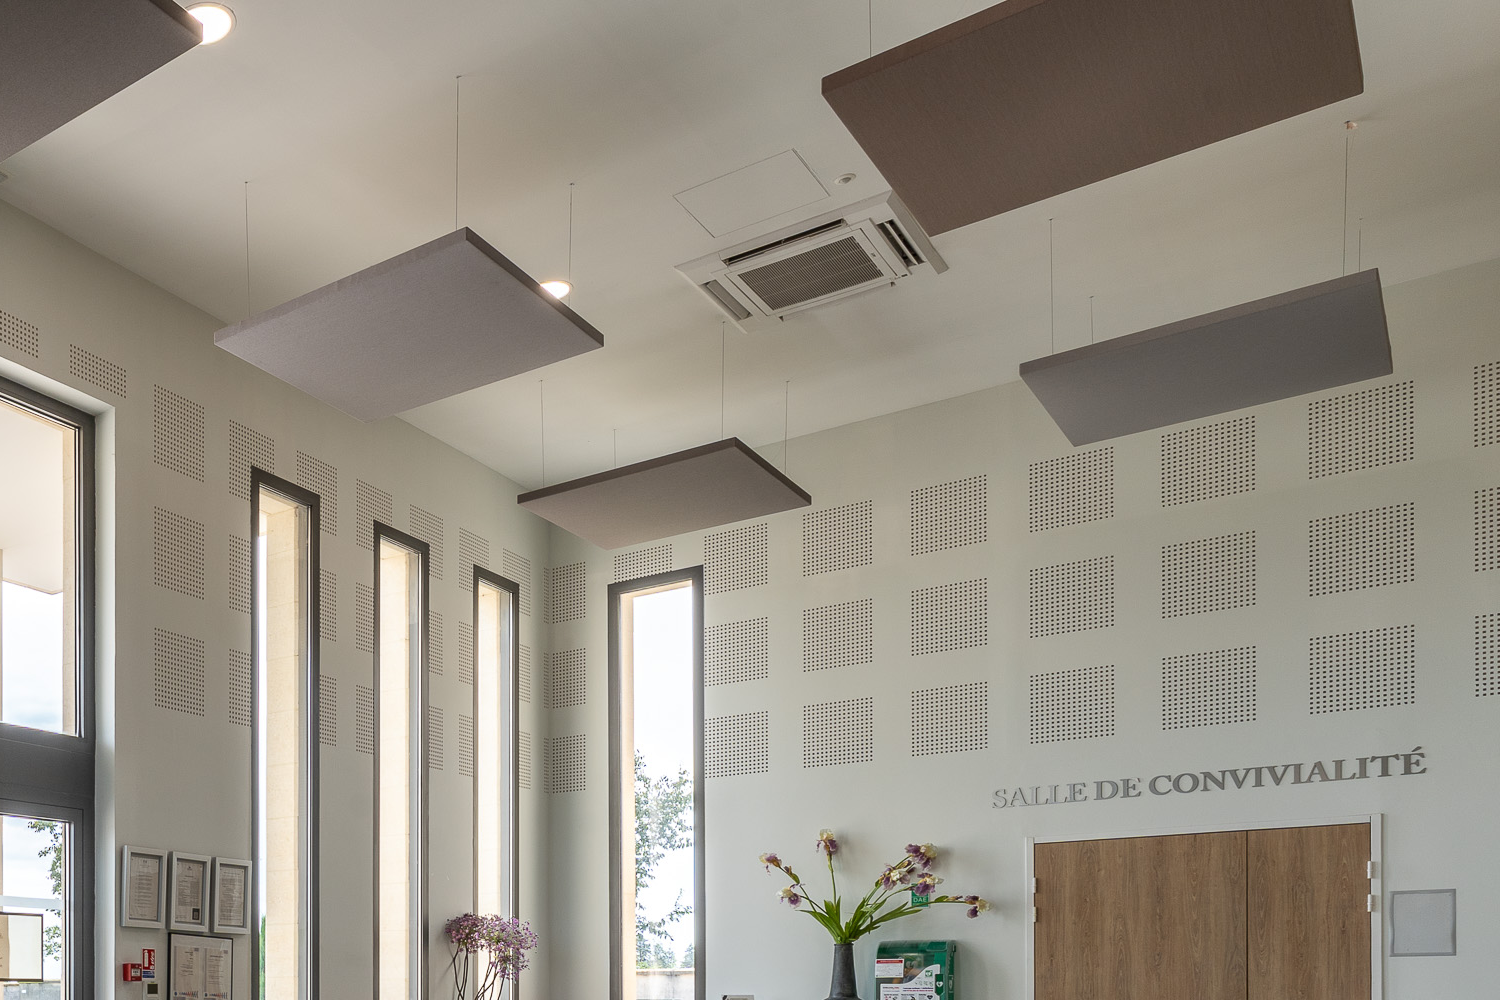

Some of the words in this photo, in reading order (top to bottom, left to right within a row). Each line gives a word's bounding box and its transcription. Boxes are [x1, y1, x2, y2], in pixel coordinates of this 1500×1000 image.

[992, 782, 1088, 809] SALLE
[1094, 777, 1141, 801] DE
[1148, 746, 1427, 796] CONVIVIALITÉ
